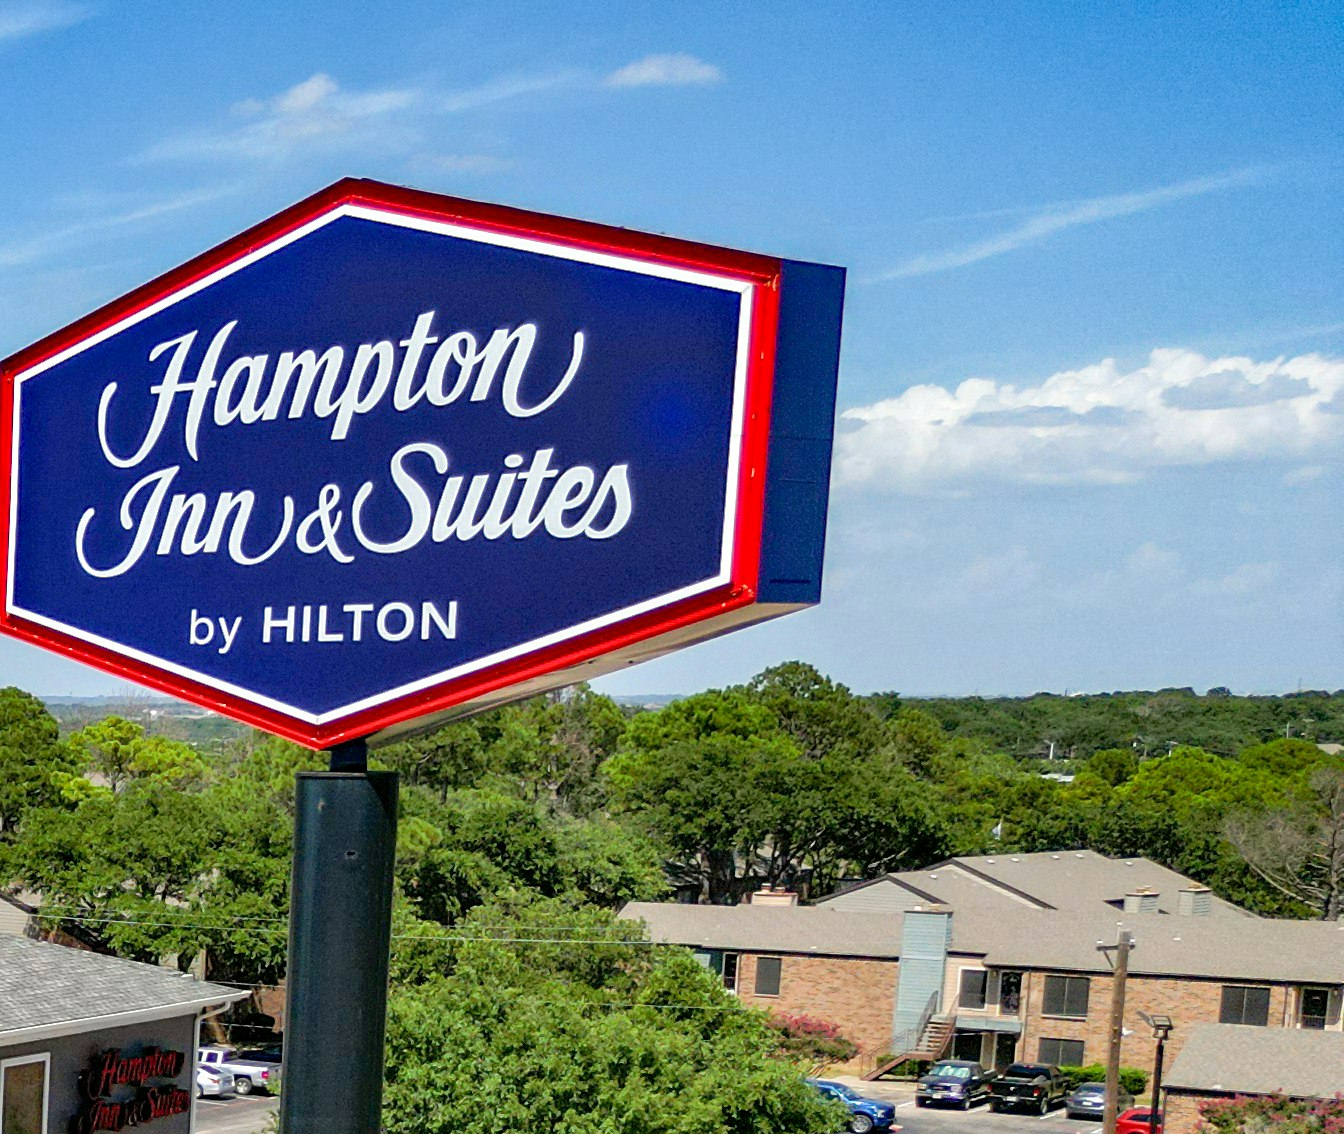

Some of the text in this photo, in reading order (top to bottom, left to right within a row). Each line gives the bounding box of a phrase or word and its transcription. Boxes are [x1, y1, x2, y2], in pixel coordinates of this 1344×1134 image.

[96, 310, 585, 468] Hampton
[75, 442, 633, 578] Inn & Suites
[189, 600, 458, 654] by HILTON
[80, 1046, 184, 1100] Hampton
[138, 1087, 190, 1123] Suites
